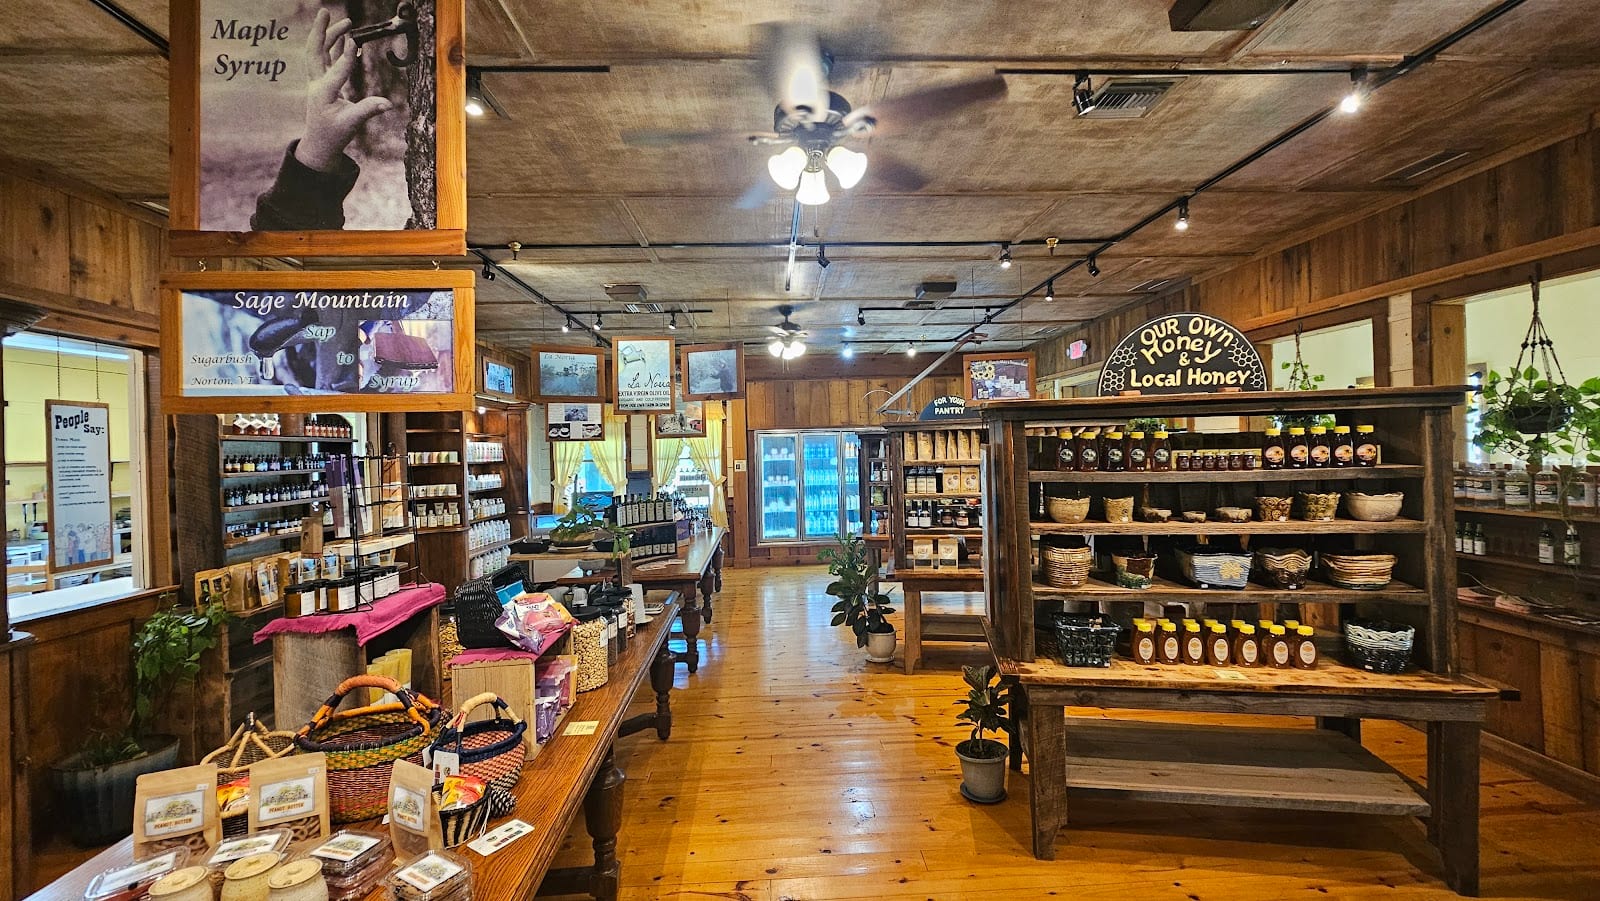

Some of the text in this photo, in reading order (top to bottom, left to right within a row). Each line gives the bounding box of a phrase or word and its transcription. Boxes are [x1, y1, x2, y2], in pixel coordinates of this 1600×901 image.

[210, 19, 289, 46] Maple
[214, 53, 287, 81] Syrup
[232, 291, 410, 315] Sage Mountain
[304, 324, 336, 341] Sap
[1140, 318, 1180, 346] OUR
[337, 351, 354, 365] to
[1140, 336, 1222, 364] Honey
[191, 353, 252, 367] Sugarbush
[1178, 352, 1190, 366] &
[370, 375, 419, 391] Syrup
[1130, 368, 1182, 387] Local
[934, 396, 965, 406] FOR YOUR
[55, 409, 89, 430] People
[934, 407, 965, 415] PANTRY
[83, 423, 105, 436] Say:
